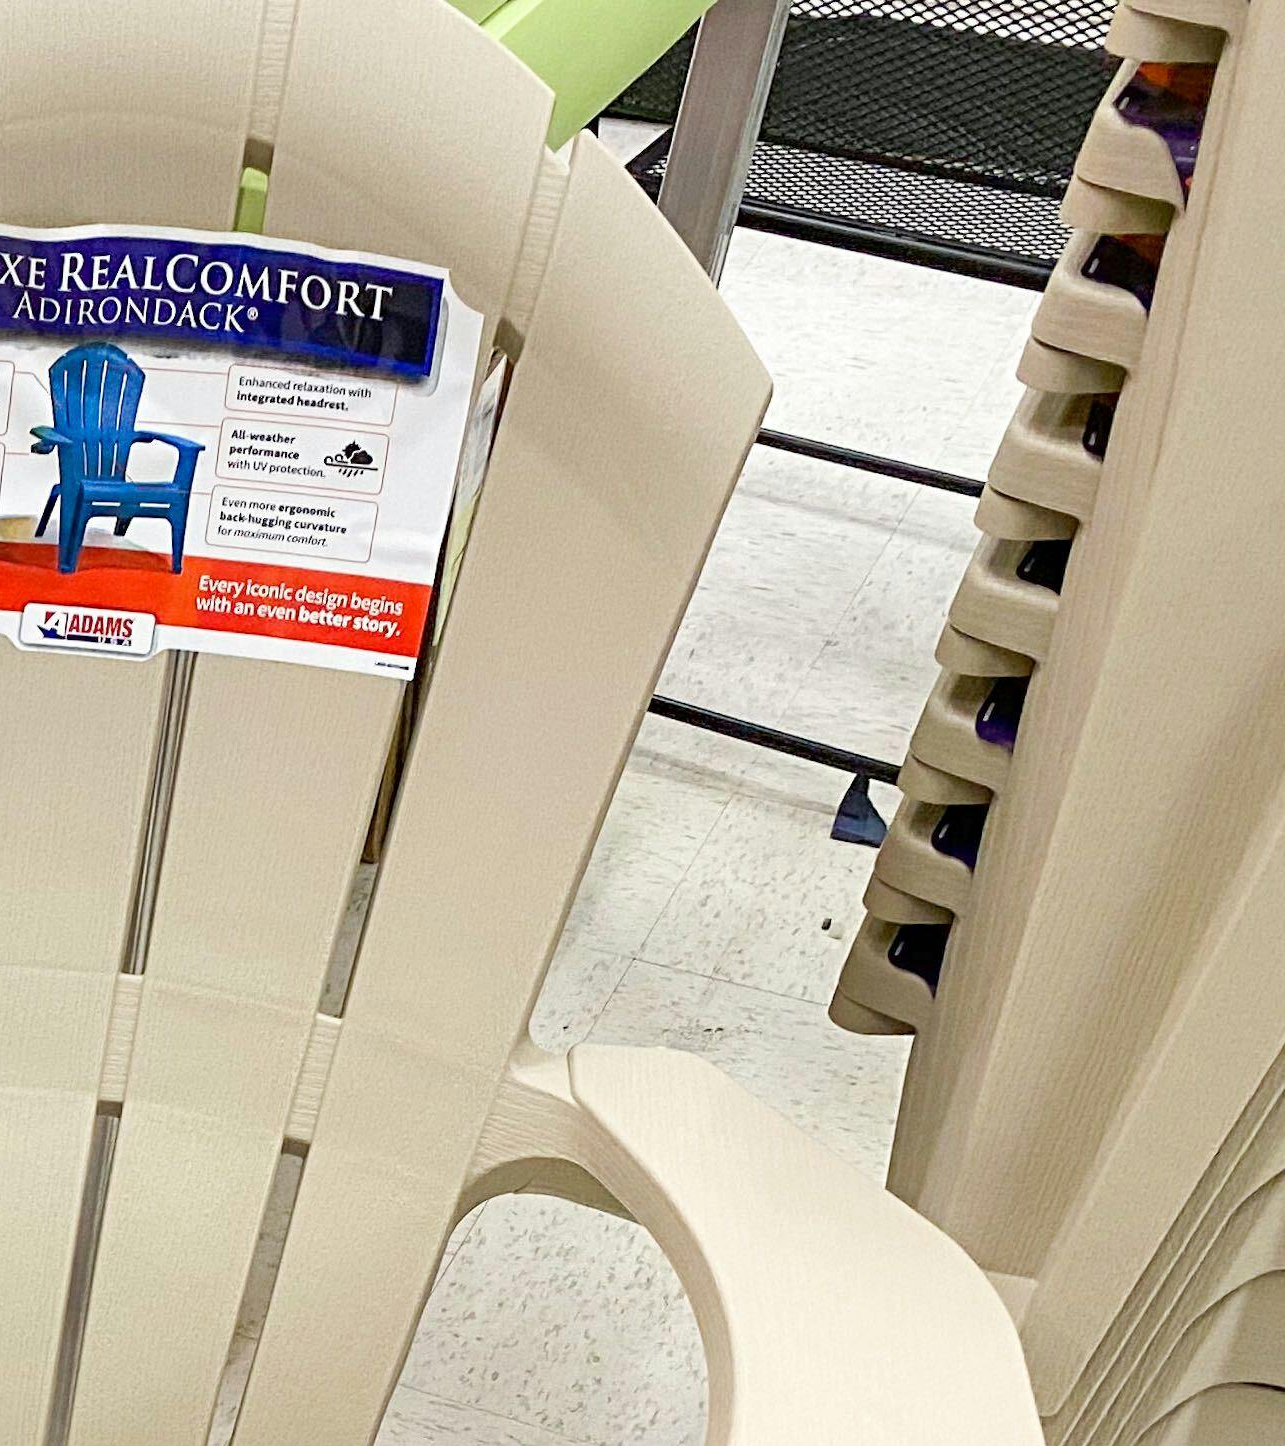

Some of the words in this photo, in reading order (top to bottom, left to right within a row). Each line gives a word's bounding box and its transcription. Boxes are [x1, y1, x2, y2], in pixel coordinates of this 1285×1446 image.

[238, 376, 291, 390] Enhanced
[293, 382, 346, 396] relaxation
[348, 387, 372, 398] with
[237, 390, 294, 405] integrated
[296, 395, 349, 411] headrest.
[231, 429, 296, 444] All-weather
[229, 444, 300, 460] performance
[228, 460, 251, 470] with
[253, 462, 269, 472] UV
[222, 497, 247, 508] Even
[249, 501, 276, 512] more
[278, 504, 336, 518] ergonomic
[217, 525, 232, 536] for
[234, 529, 285, 542] maximum
[294, 519, 347, 534] curvature
[199, 574, 244, 598] Every
[246, 579, 294, 601] iconic
[295, 585, 348, 610] design
[350, 592, 404, 617] begins
[68, 614, 134, 638] ADAMS
[196, 594, 232, 613] with
[233, 601, 255, 616] an
[257, 603, 297, 621] even
[298, 605, 352, 628] better
[353, 615, 402, 638] story.
